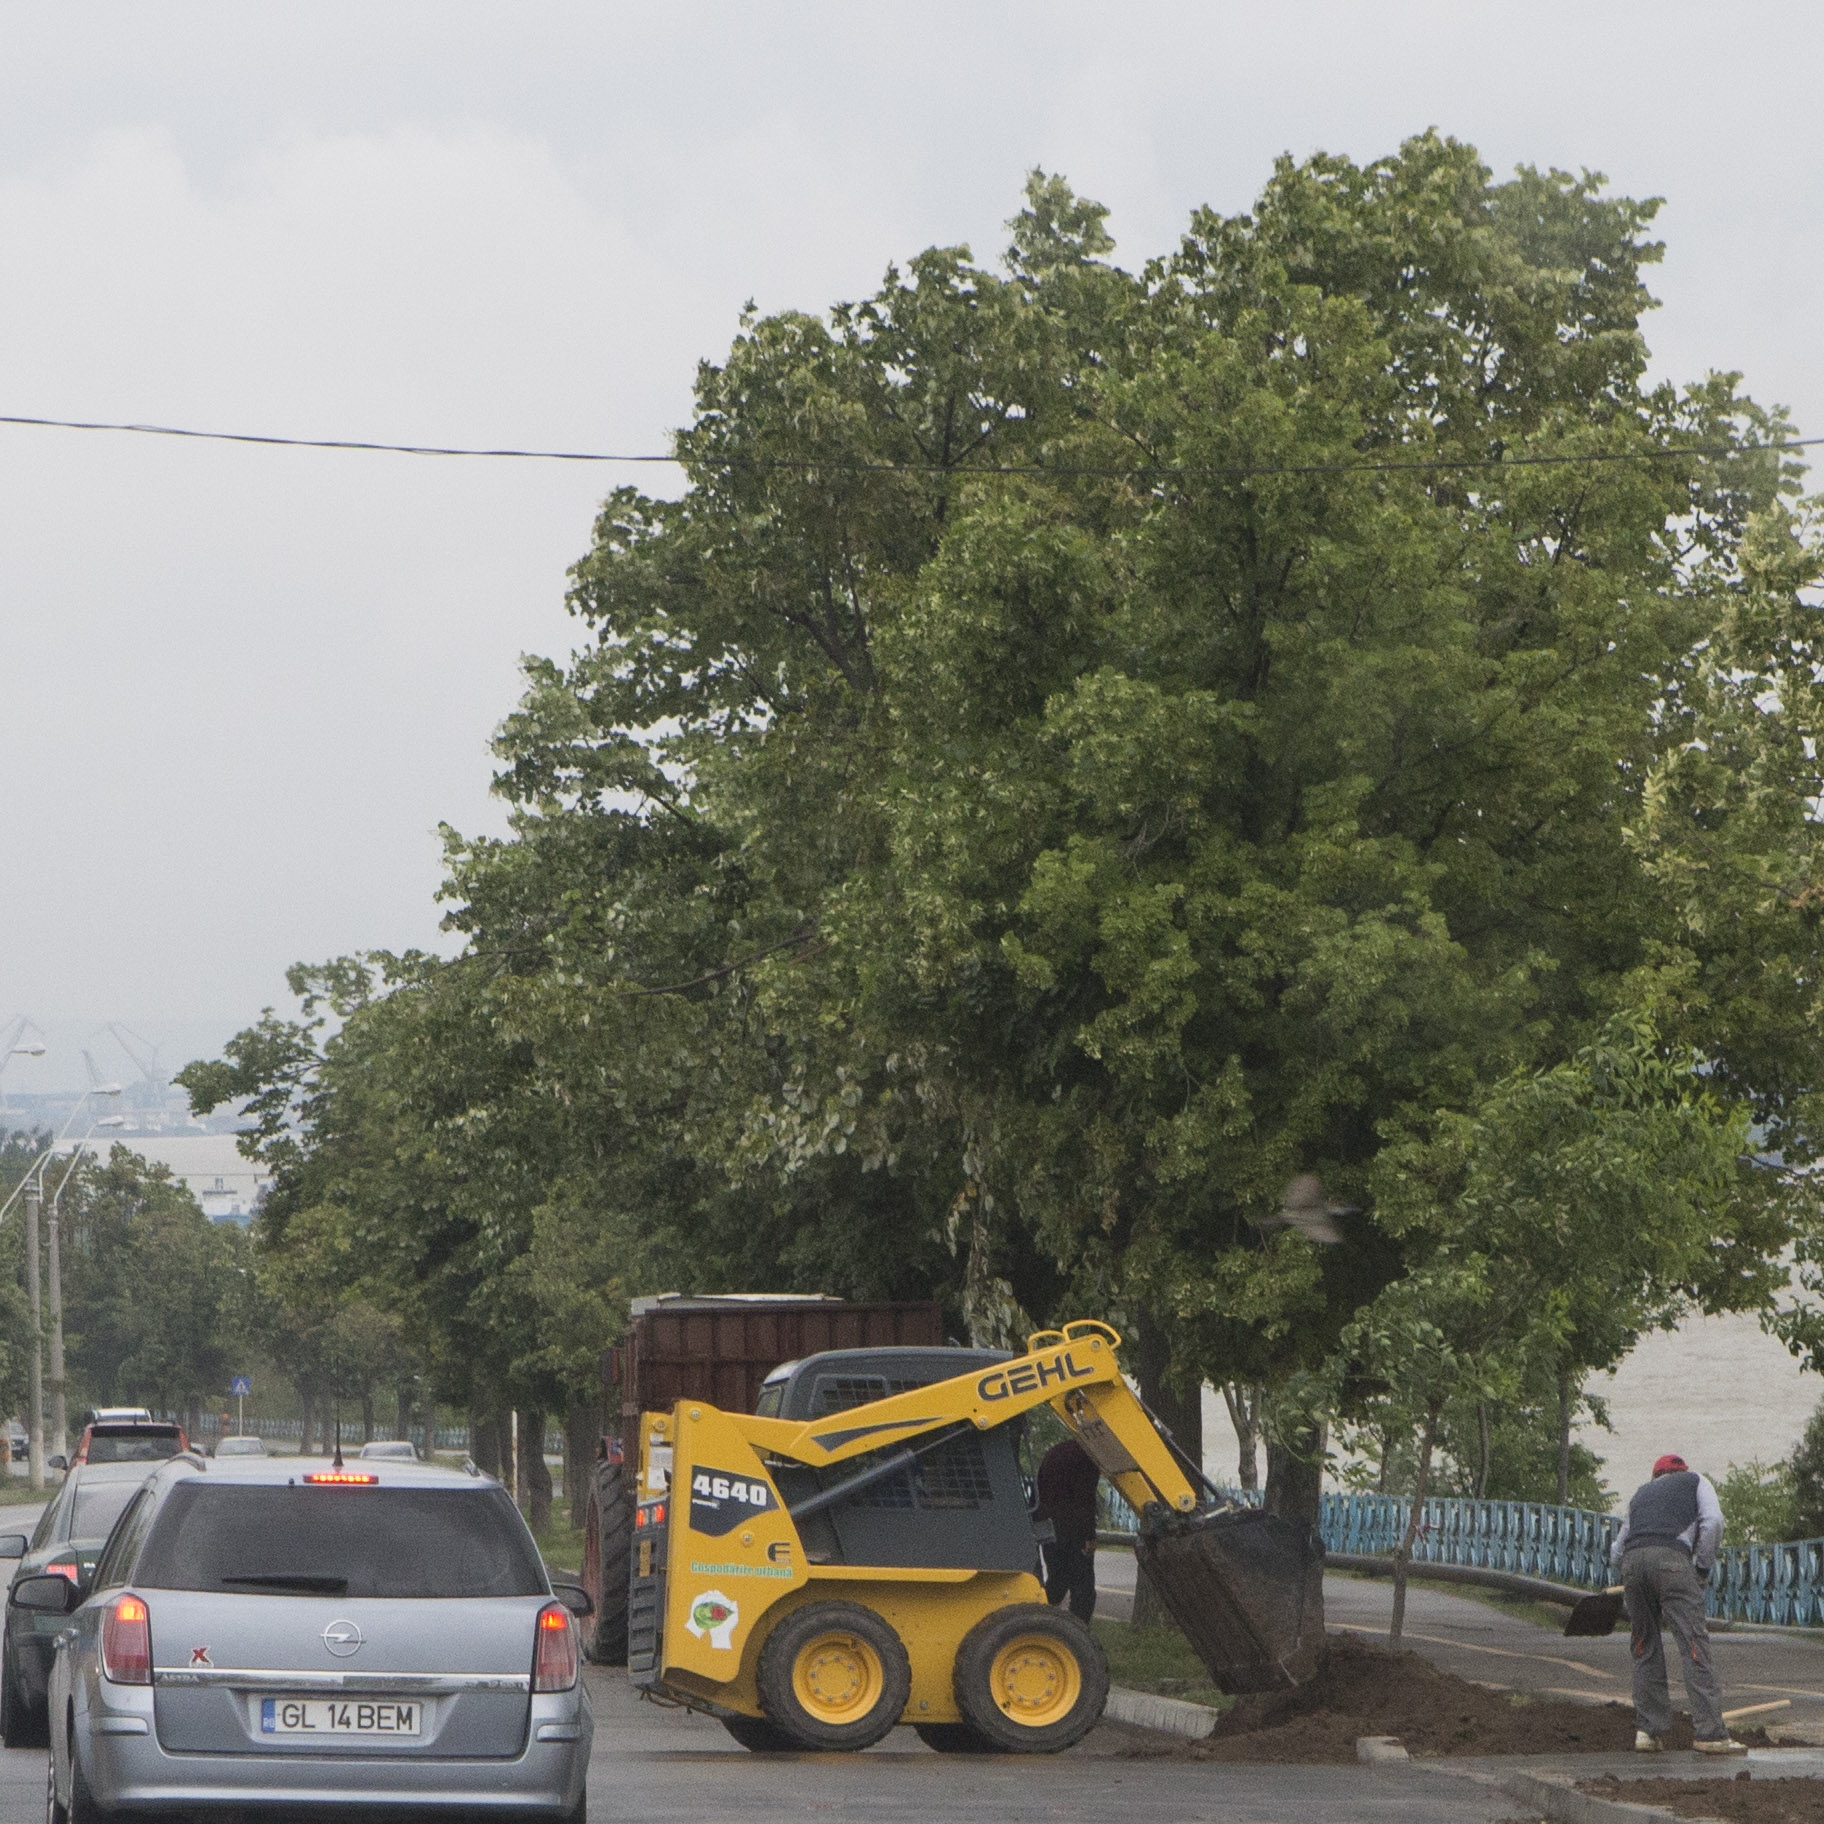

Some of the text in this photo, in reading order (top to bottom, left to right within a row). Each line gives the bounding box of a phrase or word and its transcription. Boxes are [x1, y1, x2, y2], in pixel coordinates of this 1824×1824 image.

[978, 1352, 1094, 1401] GEHL
[693, 1474, 768, 1507] 4640
[282, 1704, 413, 1731] GL 14 BEM
